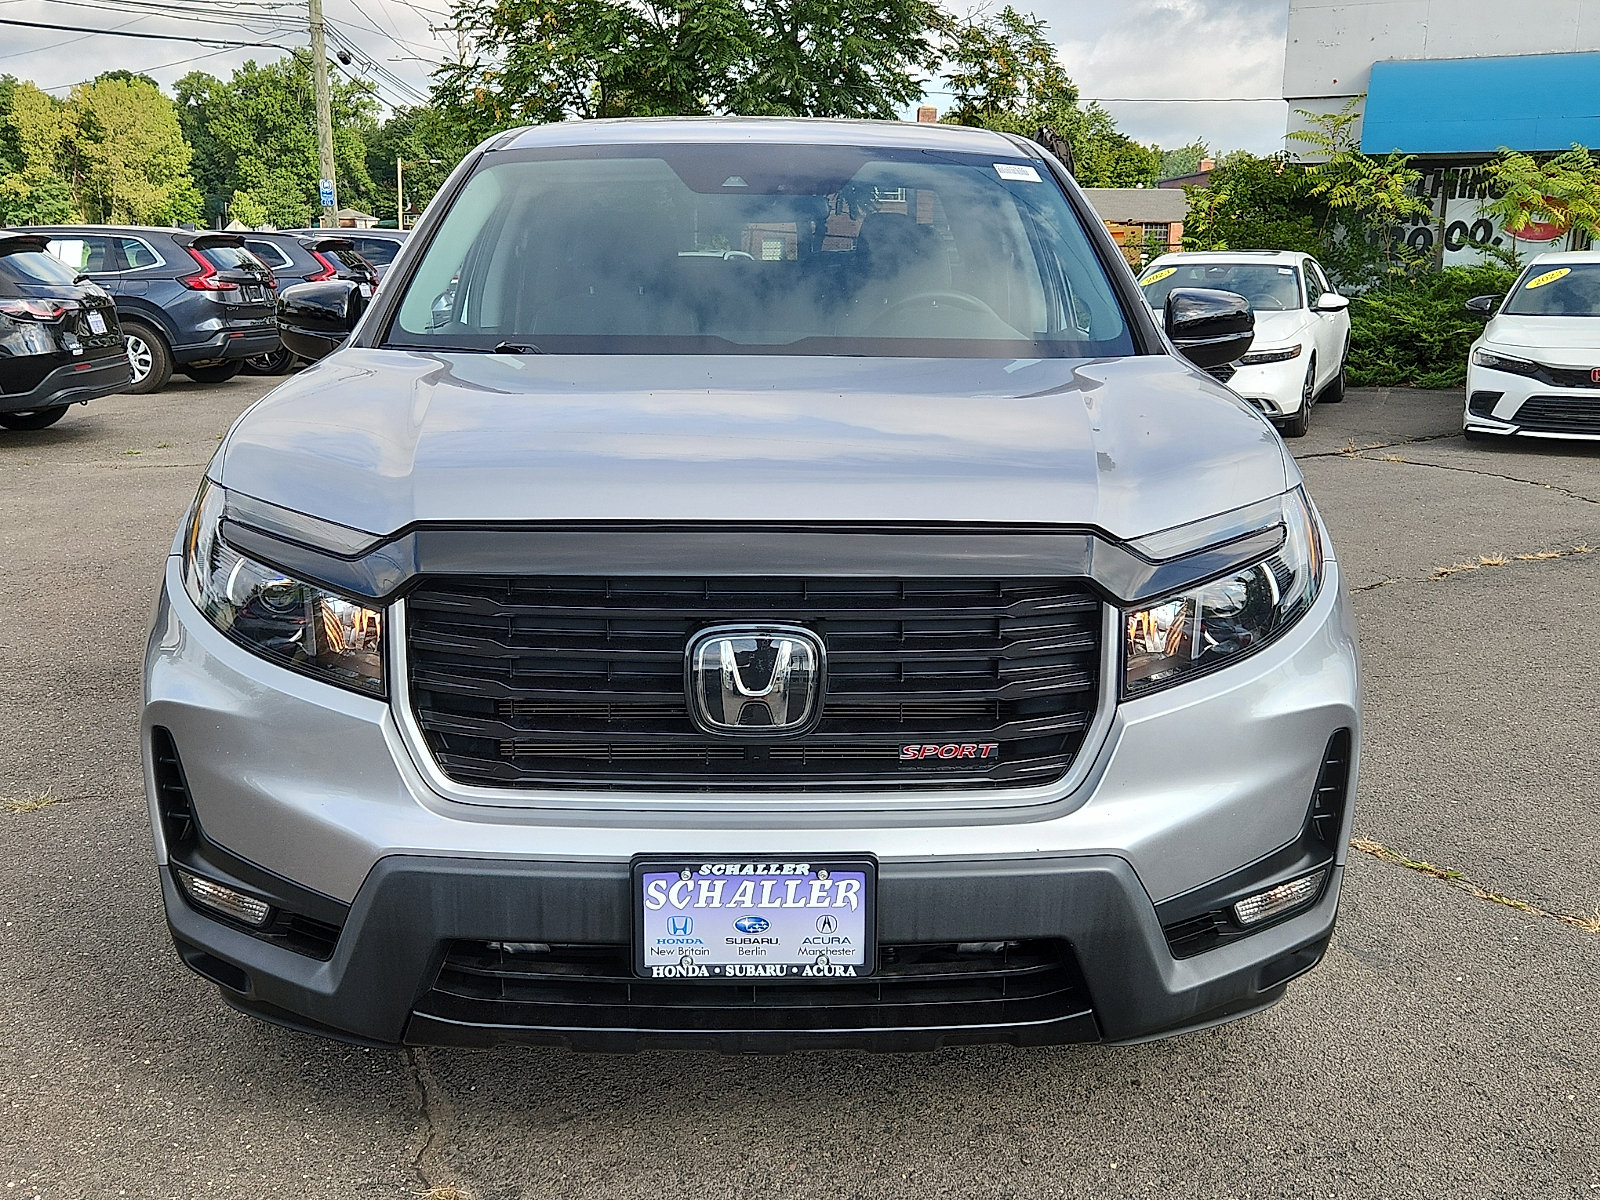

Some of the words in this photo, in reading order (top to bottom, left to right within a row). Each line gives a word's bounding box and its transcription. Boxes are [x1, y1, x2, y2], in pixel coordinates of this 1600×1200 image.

[899, 743, 999, 760] SPORT
[698, 863, 810, 876] SCHALLER
[645, 879, 861, 912] SCHALLER
[725, 937, 779, 945] SUBARU
[802, 936, 851, 945] ACURA
[650, 946, 674, 956] New
[678, 946, 710, 956] Britain
[738, 946, 767, 956] Berlin
[797, 946, 856, 956] Manchester
[651, 965, 710, 978] HONDA
[725, 964, 788, 977] SUBARU
[801, 964, 857, 977] ACURA
